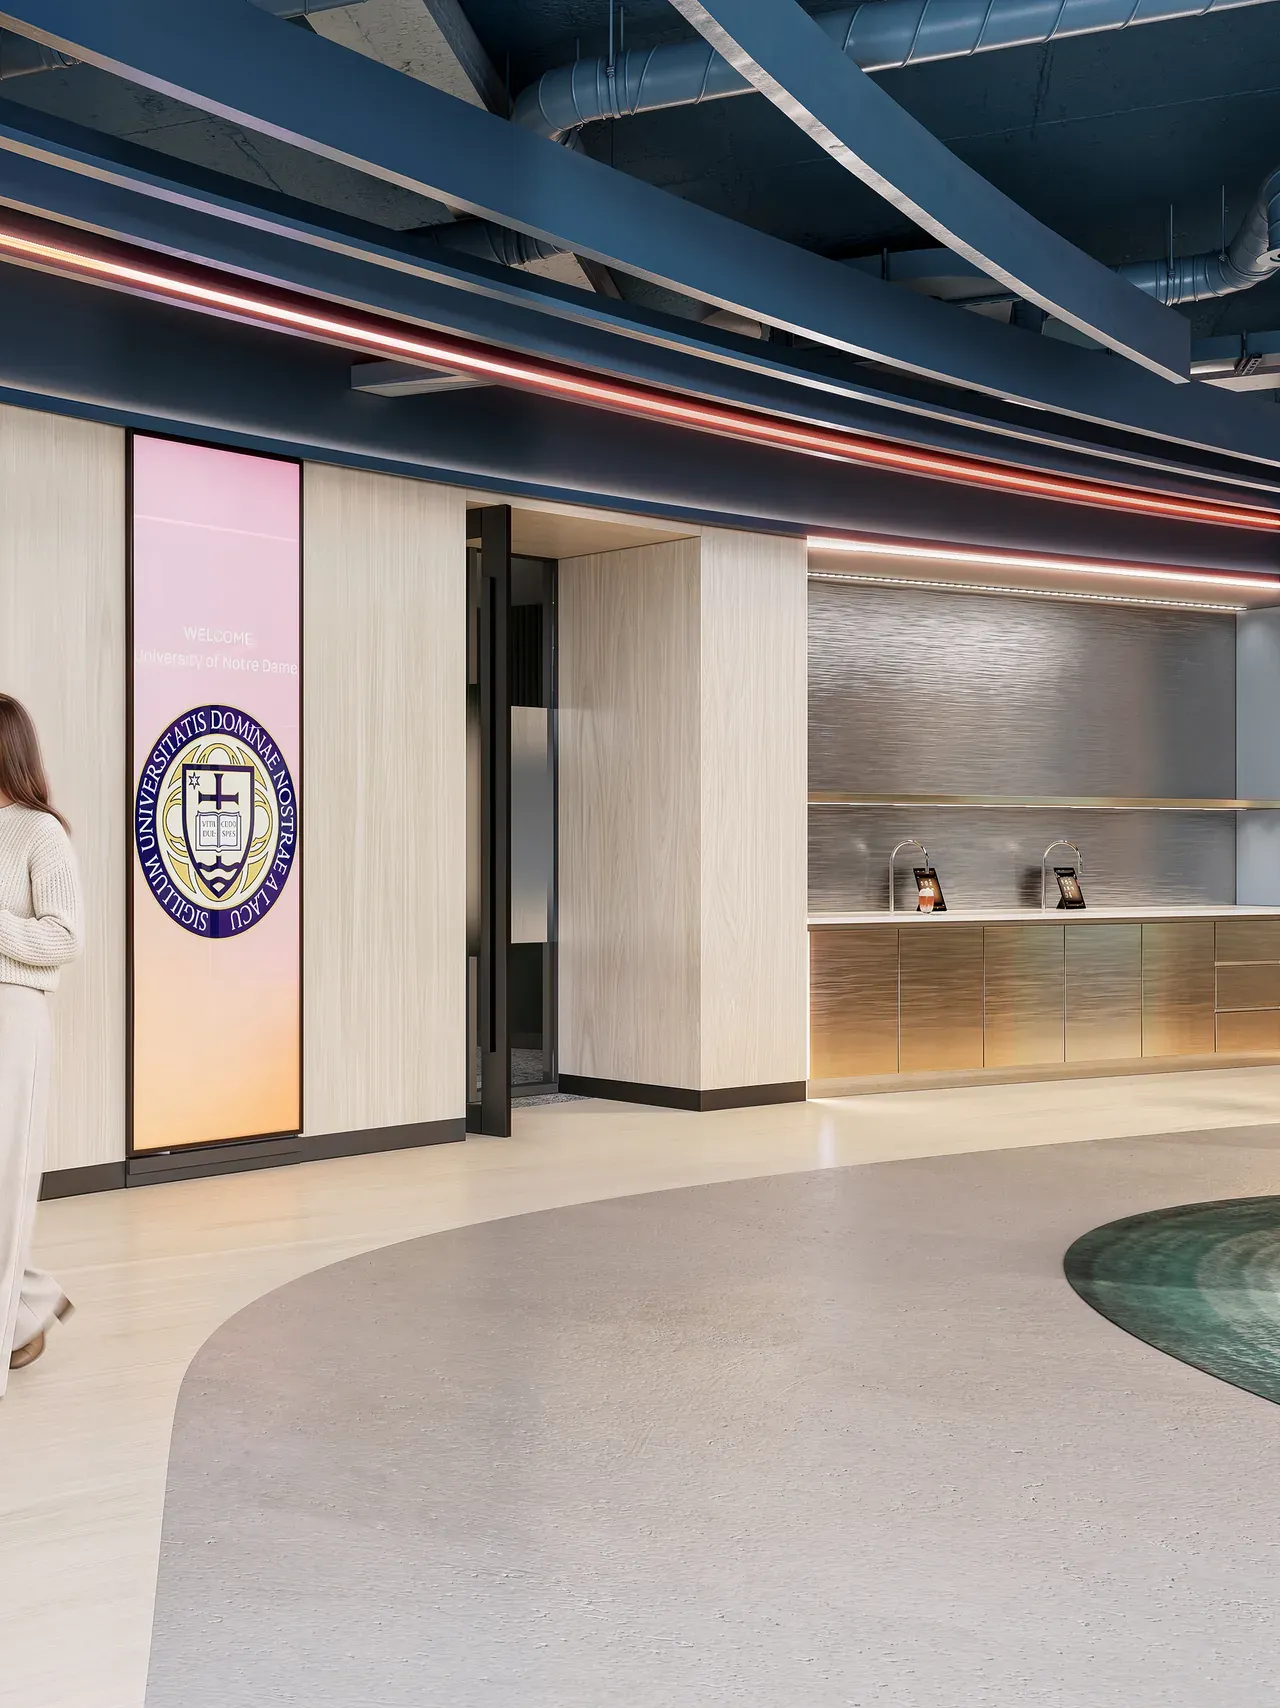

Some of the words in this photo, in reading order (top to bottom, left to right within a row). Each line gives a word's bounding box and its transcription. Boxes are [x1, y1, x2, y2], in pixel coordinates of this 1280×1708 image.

[184, 626, 253, 646] WELCOME
[206, 653, 220, 668] of
[222, 655, 259, 672] Notre
[262, 659, 298, 675] Dame
[210, 710, 280, 772] DOMINAE
[139, 711, 207, 852] UNIVERSITATIS
[273, 769, 294, 875] NOSTRAE
[145, 854, 209, 931] SIGILLUM
[265, 873, 279, 890] A
[231, 888, 270, 930] LACU
